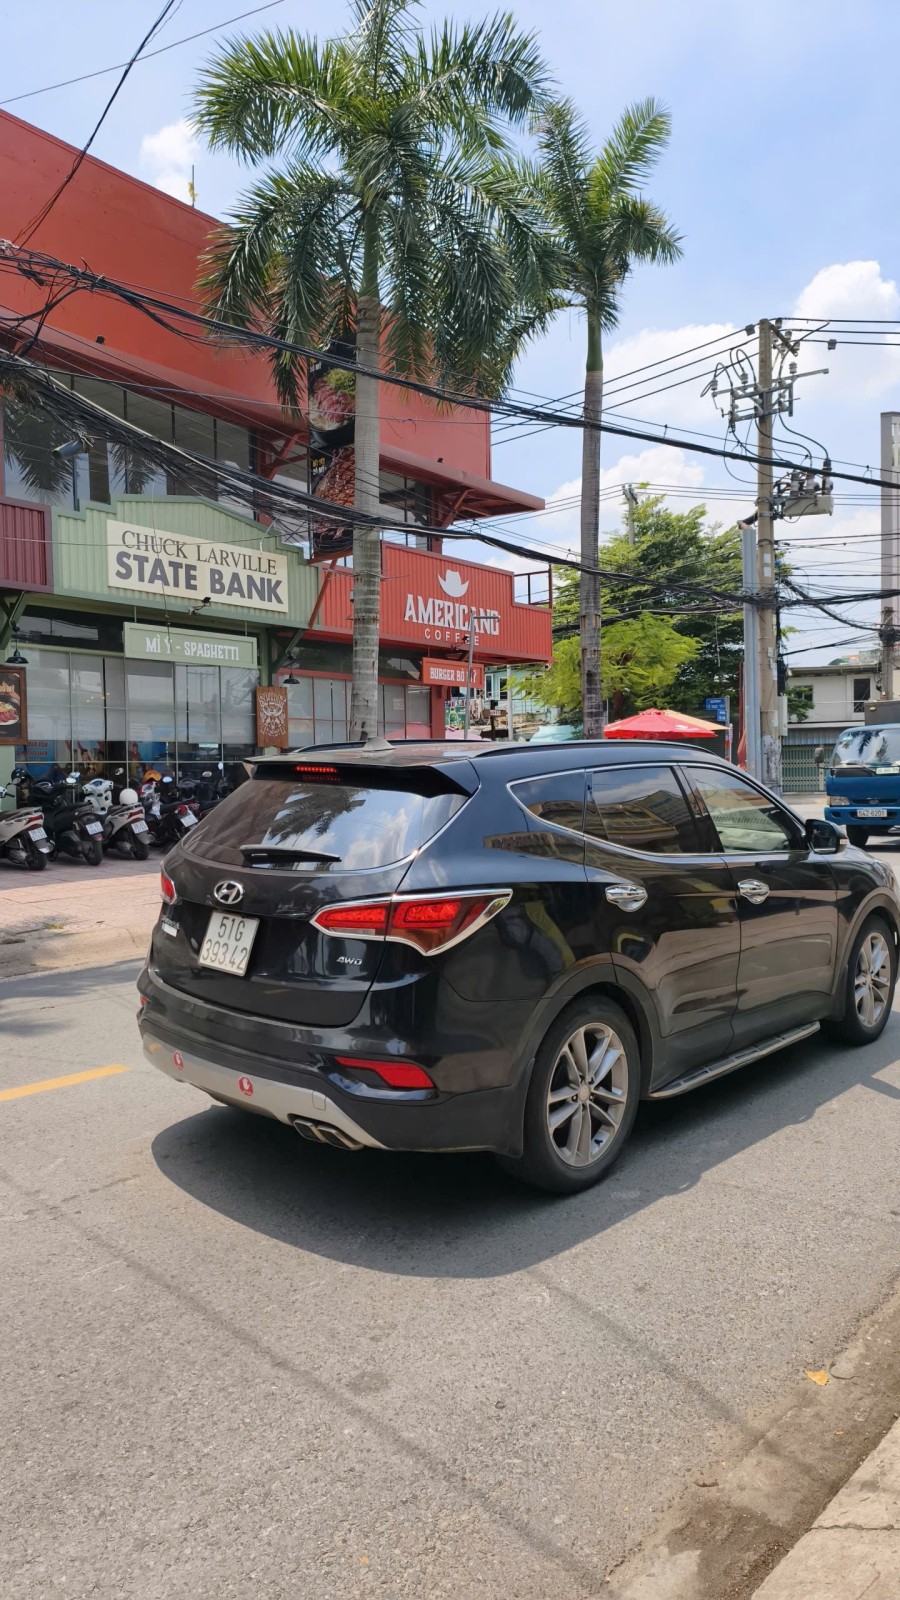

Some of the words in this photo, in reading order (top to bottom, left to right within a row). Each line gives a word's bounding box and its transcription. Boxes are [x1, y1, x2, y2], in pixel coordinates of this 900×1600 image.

[121, 530, 189, 560] CHUCK
[196, 545, 278, 575] LARVILLE
[115, 551, 198, 591] STATE
[209, 568, 284, 605] BANK
[404, 594, 500, 636] AMERICANO
[145, 633, 161, 653] MÌ
[164, 635, 173, 654] Ý
[183, 641, 240, 661] SPAGHETTI
[429, 667, 455, 681] BURGER
[217, 916, 246, 942] 51G
[201, 938, 248, 970] 393.42
